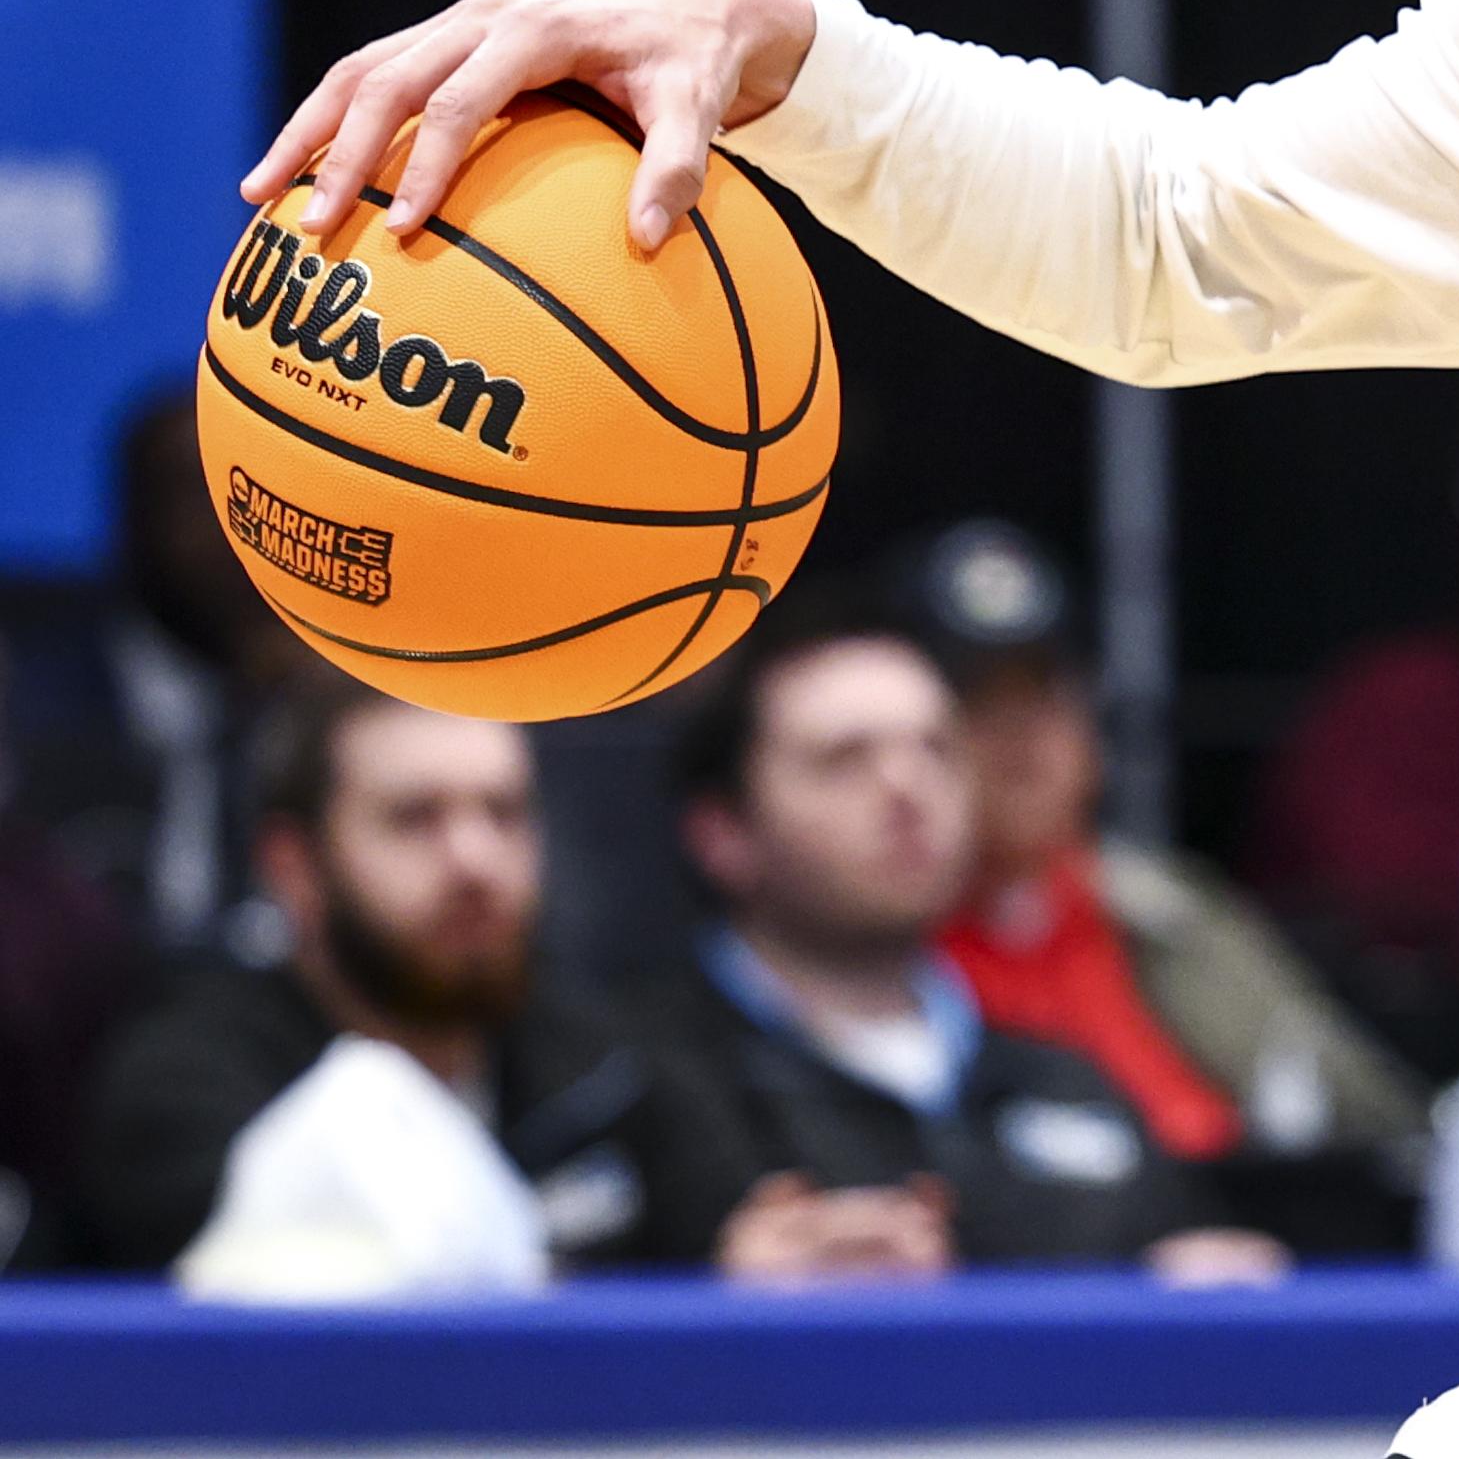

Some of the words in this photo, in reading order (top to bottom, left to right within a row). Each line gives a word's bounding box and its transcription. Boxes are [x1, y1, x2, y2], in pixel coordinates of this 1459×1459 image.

[222, 219, 512, 455] Wilson
[271, 356, 313, 387] EVO
[317, 378, 368, 413] NXT
[250, 484, 336, 554] MARCH
[260, 522, 387, 598] MADNESS
